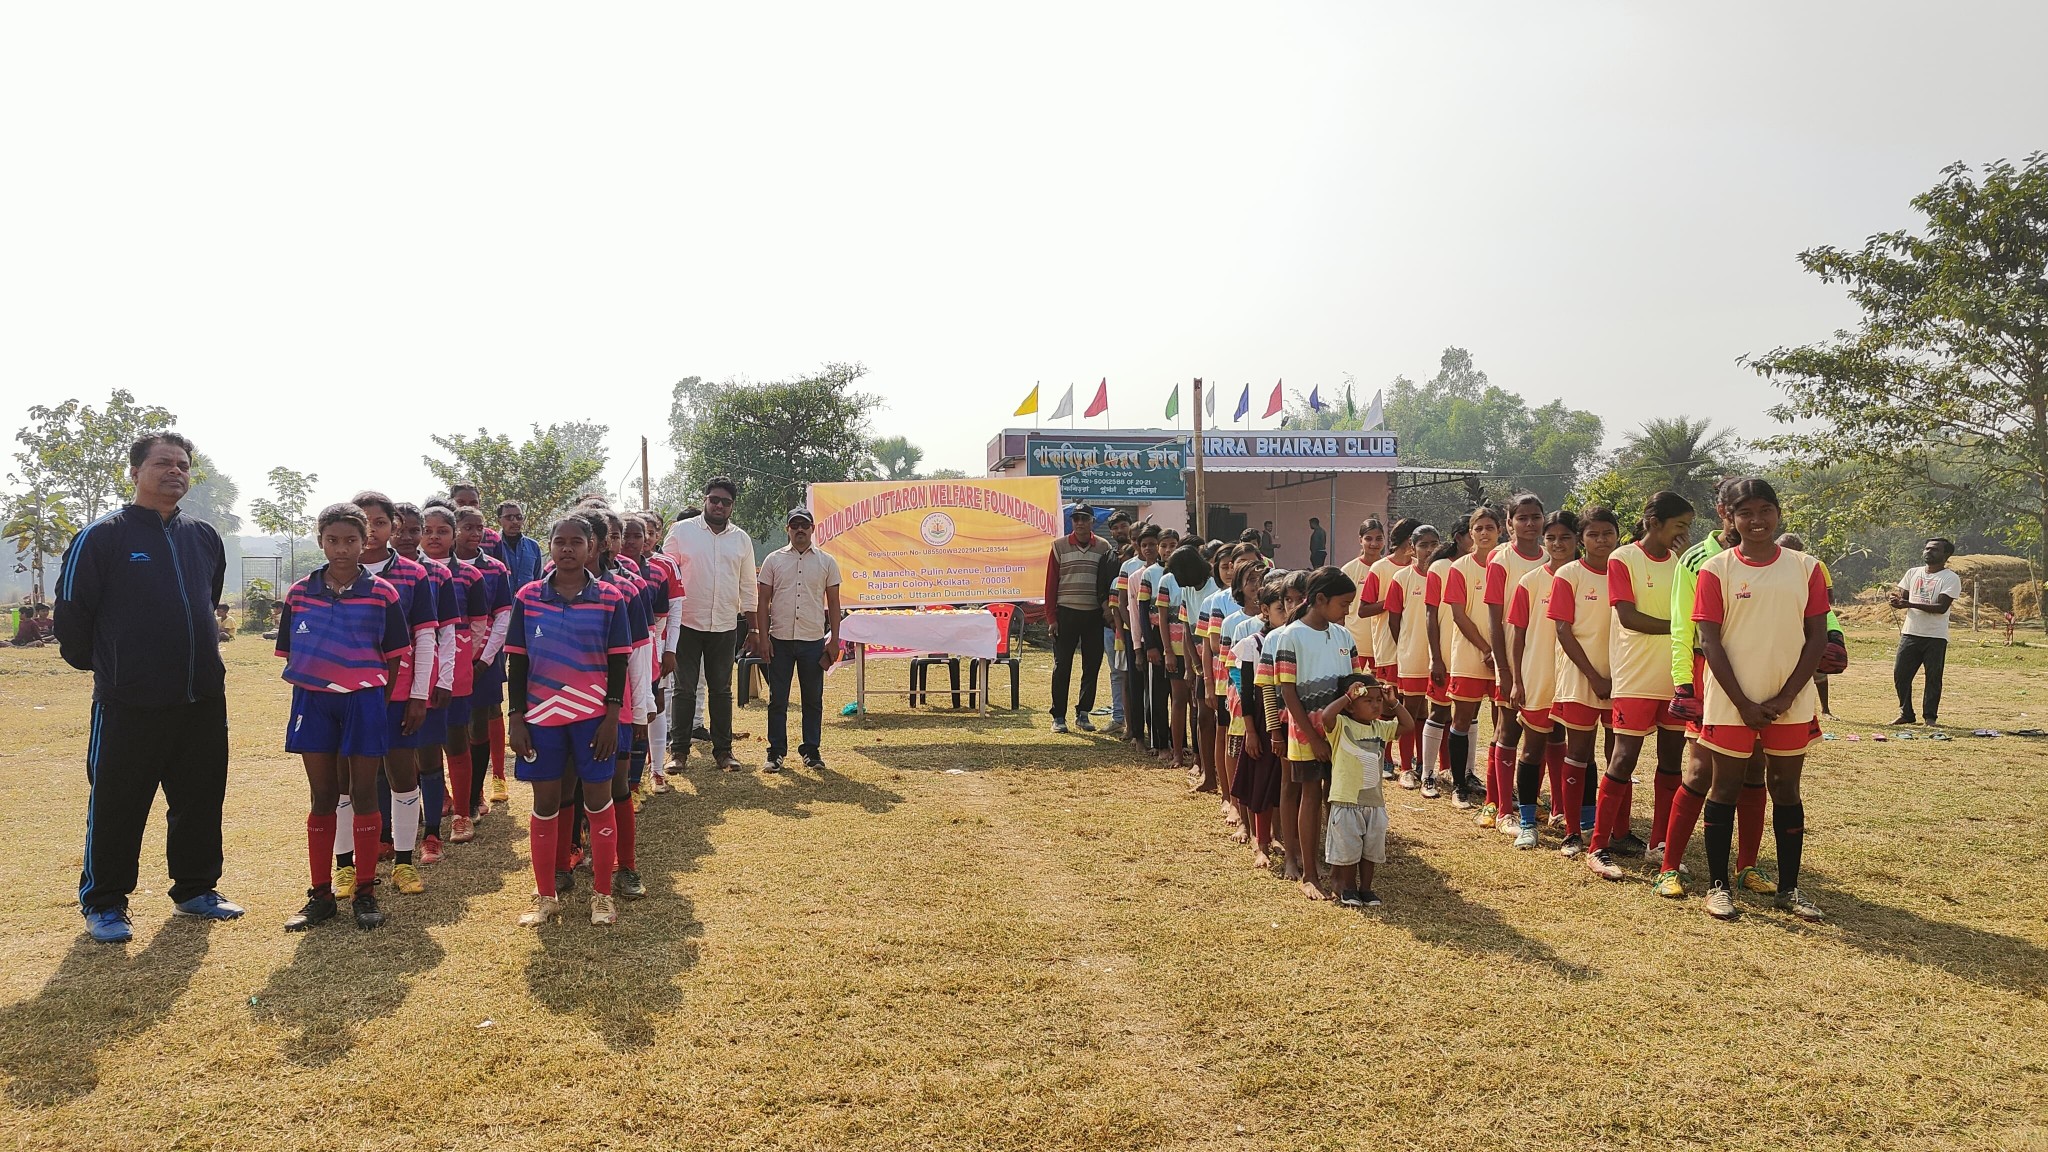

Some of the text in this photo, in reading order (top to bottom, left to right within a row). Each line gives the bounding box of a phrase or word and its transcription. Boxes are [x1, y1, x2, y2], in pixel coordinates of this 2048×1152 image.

[1256, 437, 1339, 456] BHAIRAB
[1345, 437, 1396, 456] CLUB
[817, 484, 1058, 547] DUM DUM UTTARON WELFARE FOUNDATION
[868, 550, 908, 558] Registration
[921, 567, 944, 576] Pulin
[984, 565, 1026, 574] DumDum
[868, 581, 900, 590] Rajbari
[936, 578, 971, 586] Kolkata
[981, 576, 1012, 585] 700081
[909, 590, 942, 599] Uttaran
[944, 588, 985, 597] Dumdum
[987, 586, 1022, 595] Kolkata
